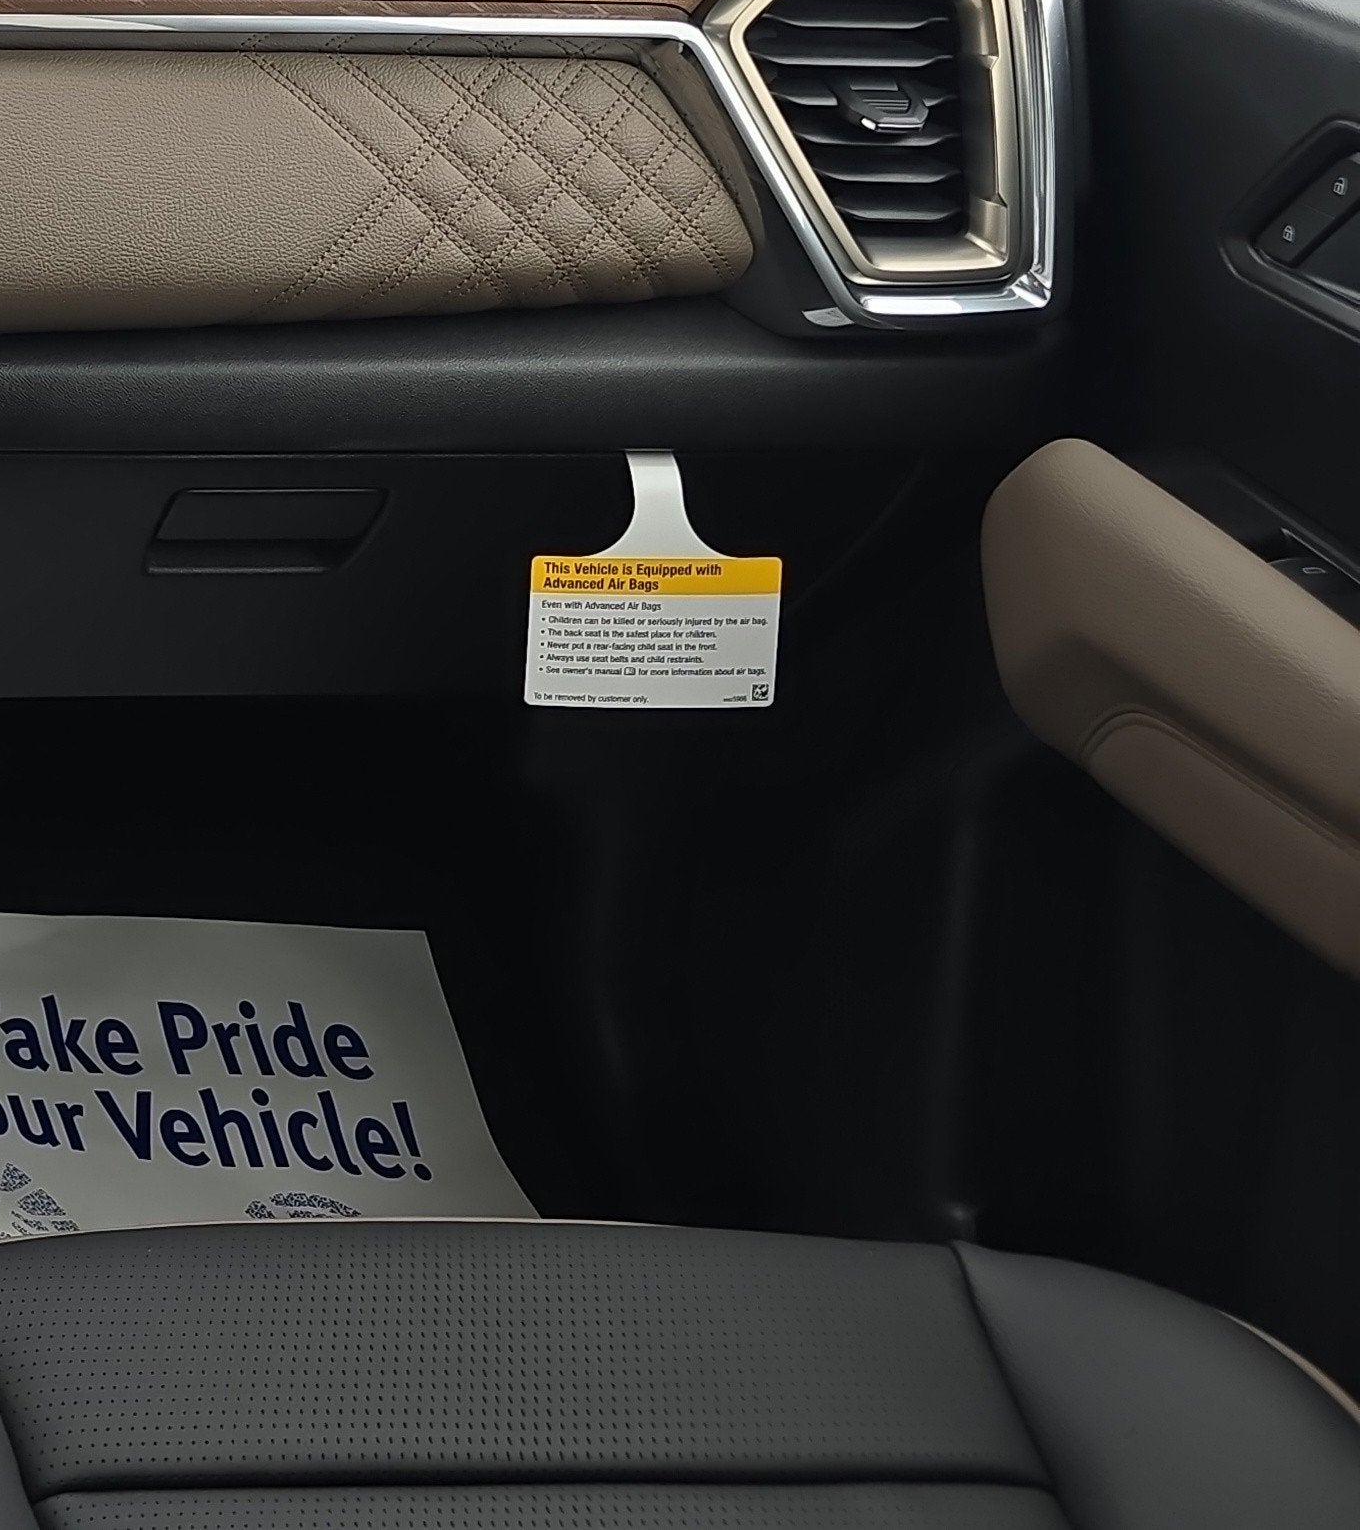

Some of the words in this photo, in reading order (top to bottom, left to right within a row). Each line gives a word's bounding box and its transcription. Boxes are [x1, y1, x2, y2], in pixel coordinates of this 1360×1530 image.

[544, 562, 570, 575] This
[575, 562, 618, 575] Vehicle
[622, 562, 632, 575] is
[636, 563, 692, 578] Equipped
[695, 564, 722, 576] with
[543, 577, 604, 590] Advanced
[608, 577, 625, 590] Air
[629, 578, 659, 592] Bags
[542, 600, 562, 609] Even
[564, 600, 583, 609] with
[585, 601, 625, 610] Advanced
[628, 601, 638, 610] Air
[641, 602, 661, 612] Bags
[548, 616, 582, 625] Children
[601, 617, 611, 625] be
[613, 617, 635, 625] killed
[647, 617, 683, 627] seriously
[685, 617, 712, 626] injured
[714, 617, 723, 627] by
[725, 617, 738, 625] the
[740, 617, 750, 625] air
[752, 617, 768, 627] bag.
[548, 628, 562, 636] The
[564, 629, 583, 637] back
[584, 630, 601, 638] seat
[603, 630, 610, 638] is
[612, 630, 624, 638] the
[626, 630, 649, 638] safest
[650, 630, 671, 639] place
[673, 630, 684, 638] for
[685, 630, 717, 638] children.
[155, 999, 370, 1082] Pride
[94, 1085, 434, 1183] Vehicle!
